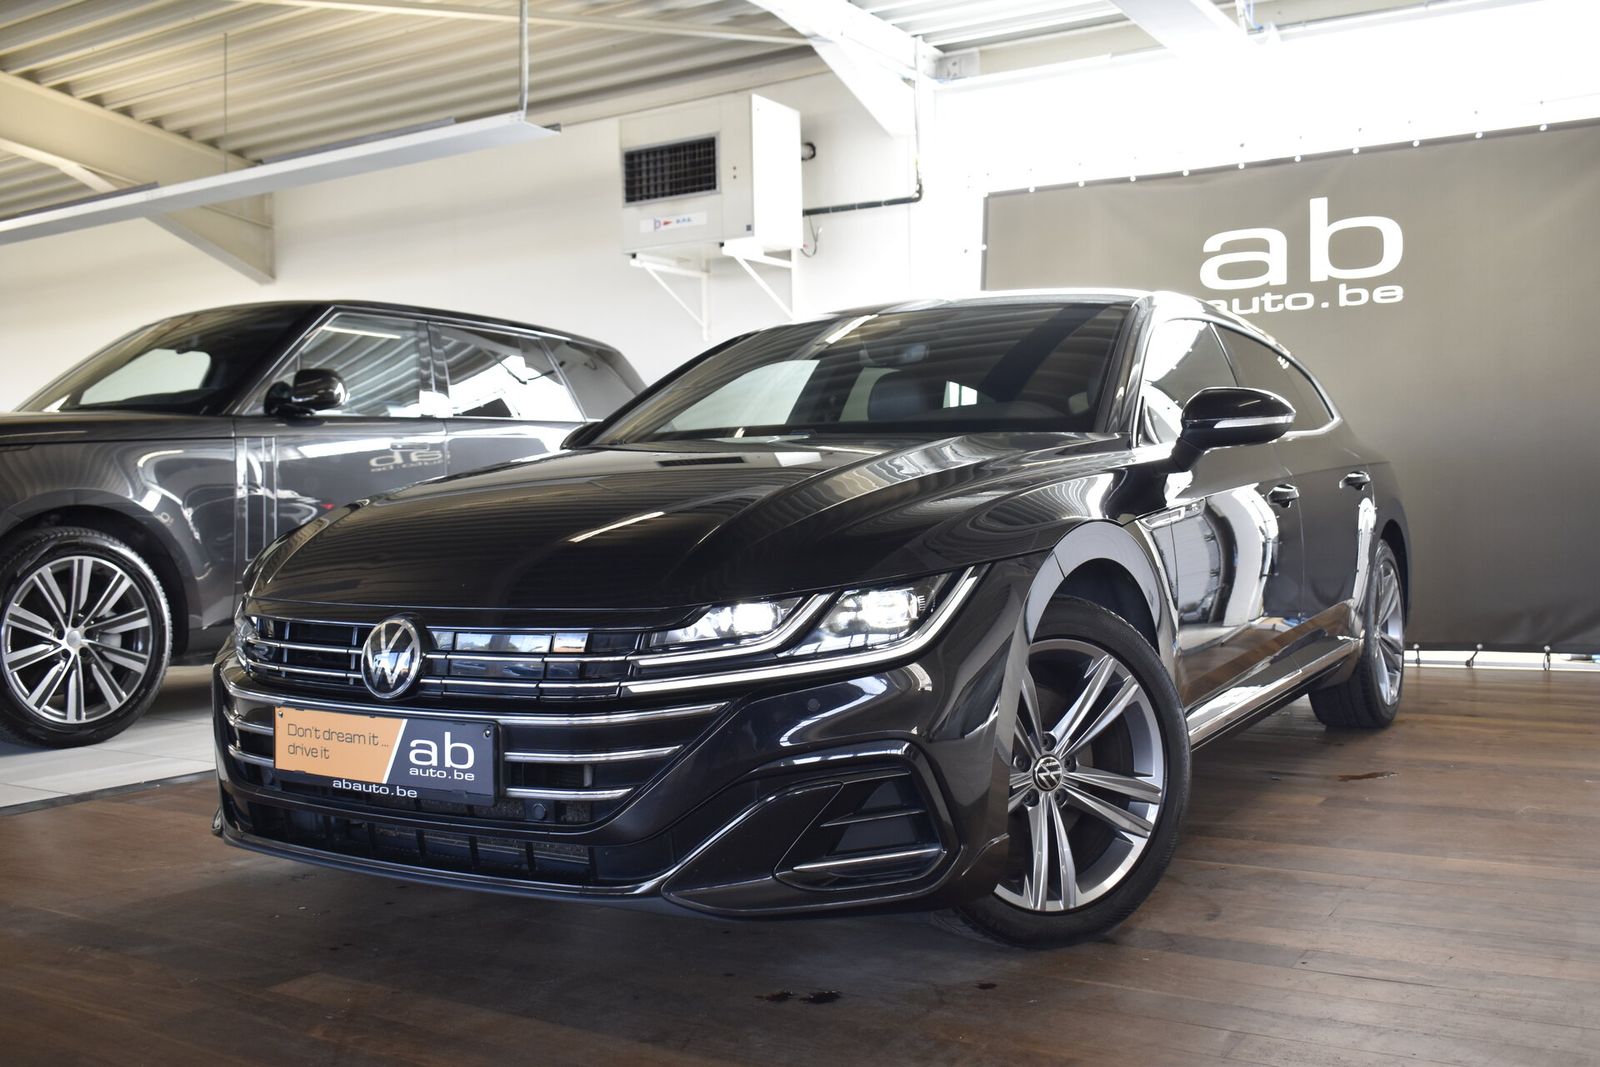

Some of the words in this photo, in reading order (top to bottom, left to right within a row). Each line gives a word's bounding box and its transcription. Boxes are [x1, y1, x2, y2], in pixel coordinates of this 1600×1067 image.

[1199, 196, 1404, 290] ab
[287, 723, 321, 740] Don't
[322, 728, 366, 745] dream
[368, 732, 379, 746] it
[287, 742, 319, 759] drive
[320, 746, 330, 760] it
[409, 731, 475, 769] ab
[409, 766, 475, 781] auto.be
[332, 778, 418, 798] abauto.be
